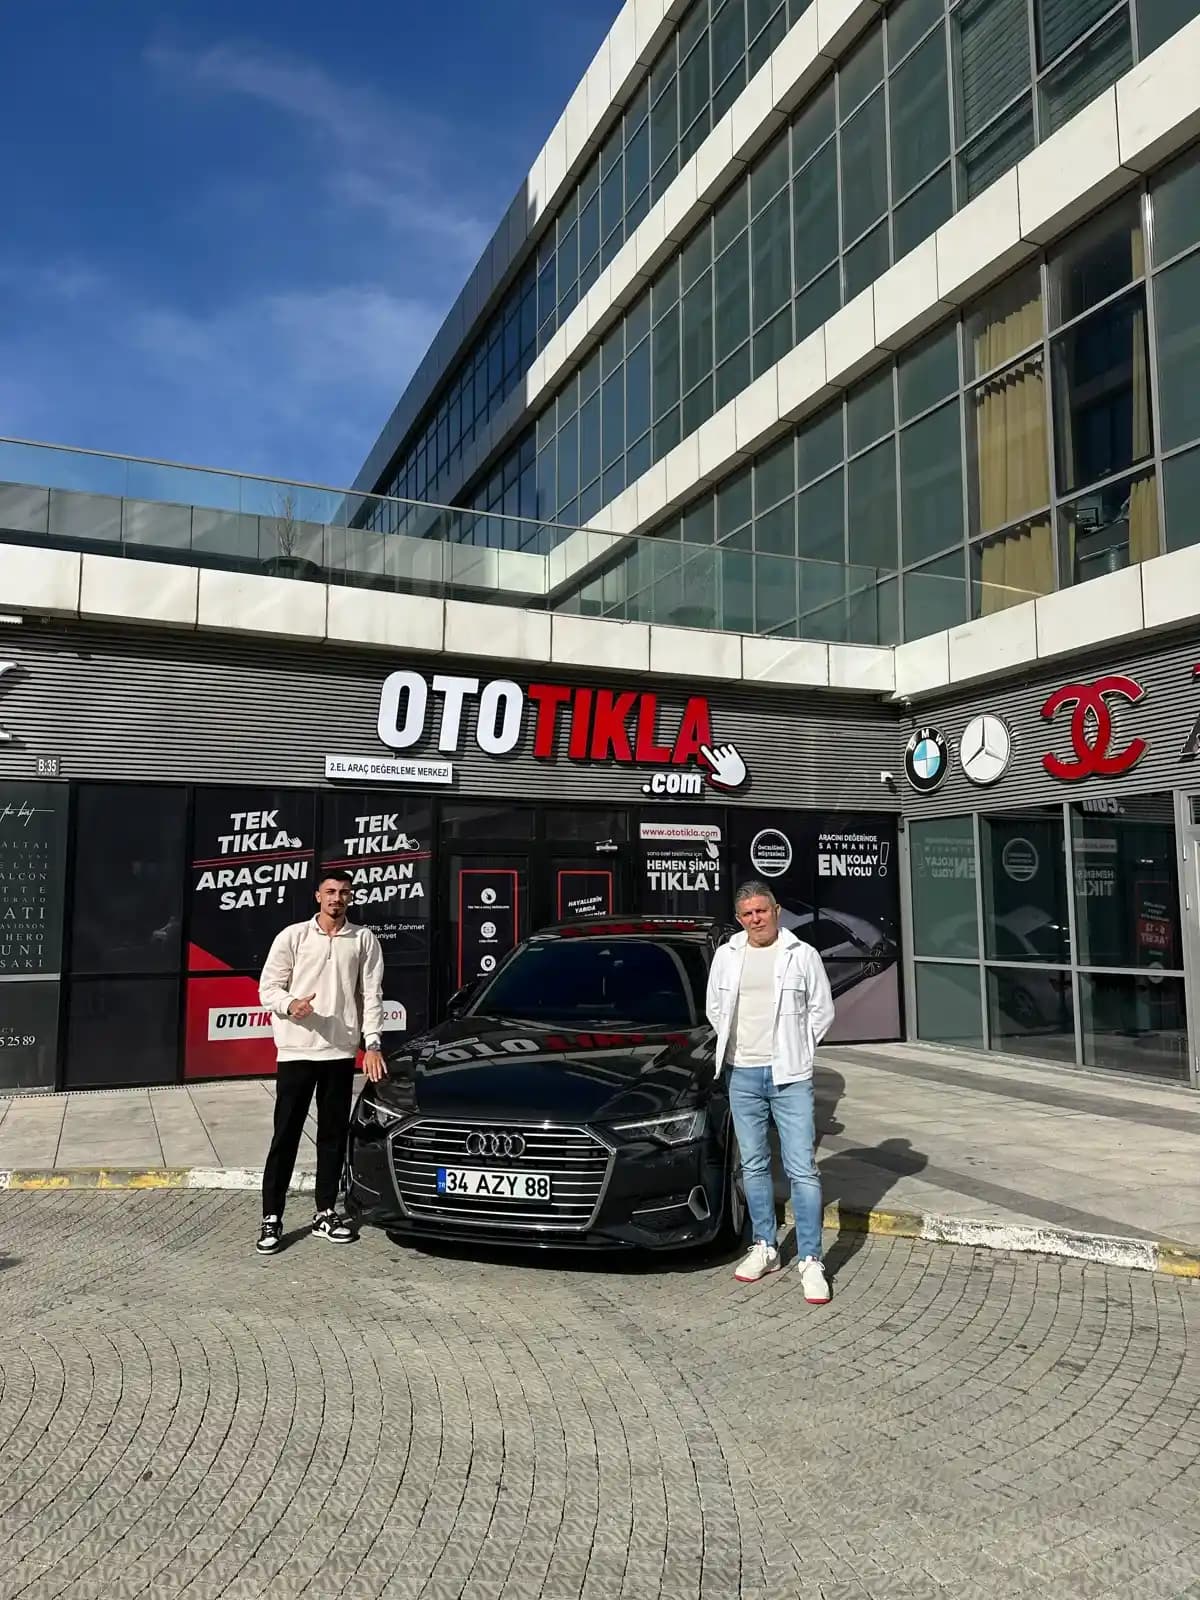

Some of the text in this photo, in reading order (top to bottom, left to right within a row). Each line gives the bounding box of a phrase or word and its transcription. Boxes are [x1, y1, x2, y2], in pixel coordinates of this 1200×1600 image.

[377, 670, 713, 765] OTOTIKLA
[38, 759, 57, 772] B:35
[330, 762, 449, 777] 2.EL ARAÇ DEĞERLEME MERKEZİ
[642, 773, 700, 794] .com
[230, 809, 279, 831] TEK
[355, 813, 399, 833] TEK
[217, 830, 291, 855] TIKLA
[343, 833, 411, 856] TIKLA
[818, 842, 878, 850] SATMANIN
[344, 863, 414, 885] ARAN
[647, 858, 720, 873] HEMEN ŞİMDİ
[818, 854, 878, 876] EN KOLAY
[847, 866, 872, 876] YOLU
[195, 861, 308, 891] ARACINI
[647, 872, 710, 891] TIKLA
[219, 887, 272, 911] SAT
[347, 882, 424, 906] SAPTA
[6, 933, 44, 941] HERO
[375, 932, 397, 940] uniyet
[216, 1012, 272, 1028] OTOTIK
[7, 1036, 20, 1046] 25
[22, 1035, 36, 1046] 89
[447, 1172, 468, 1192] 34
[476, 1174, 518, 1196] AZY
[525, 1177, 548, 1197] 88
